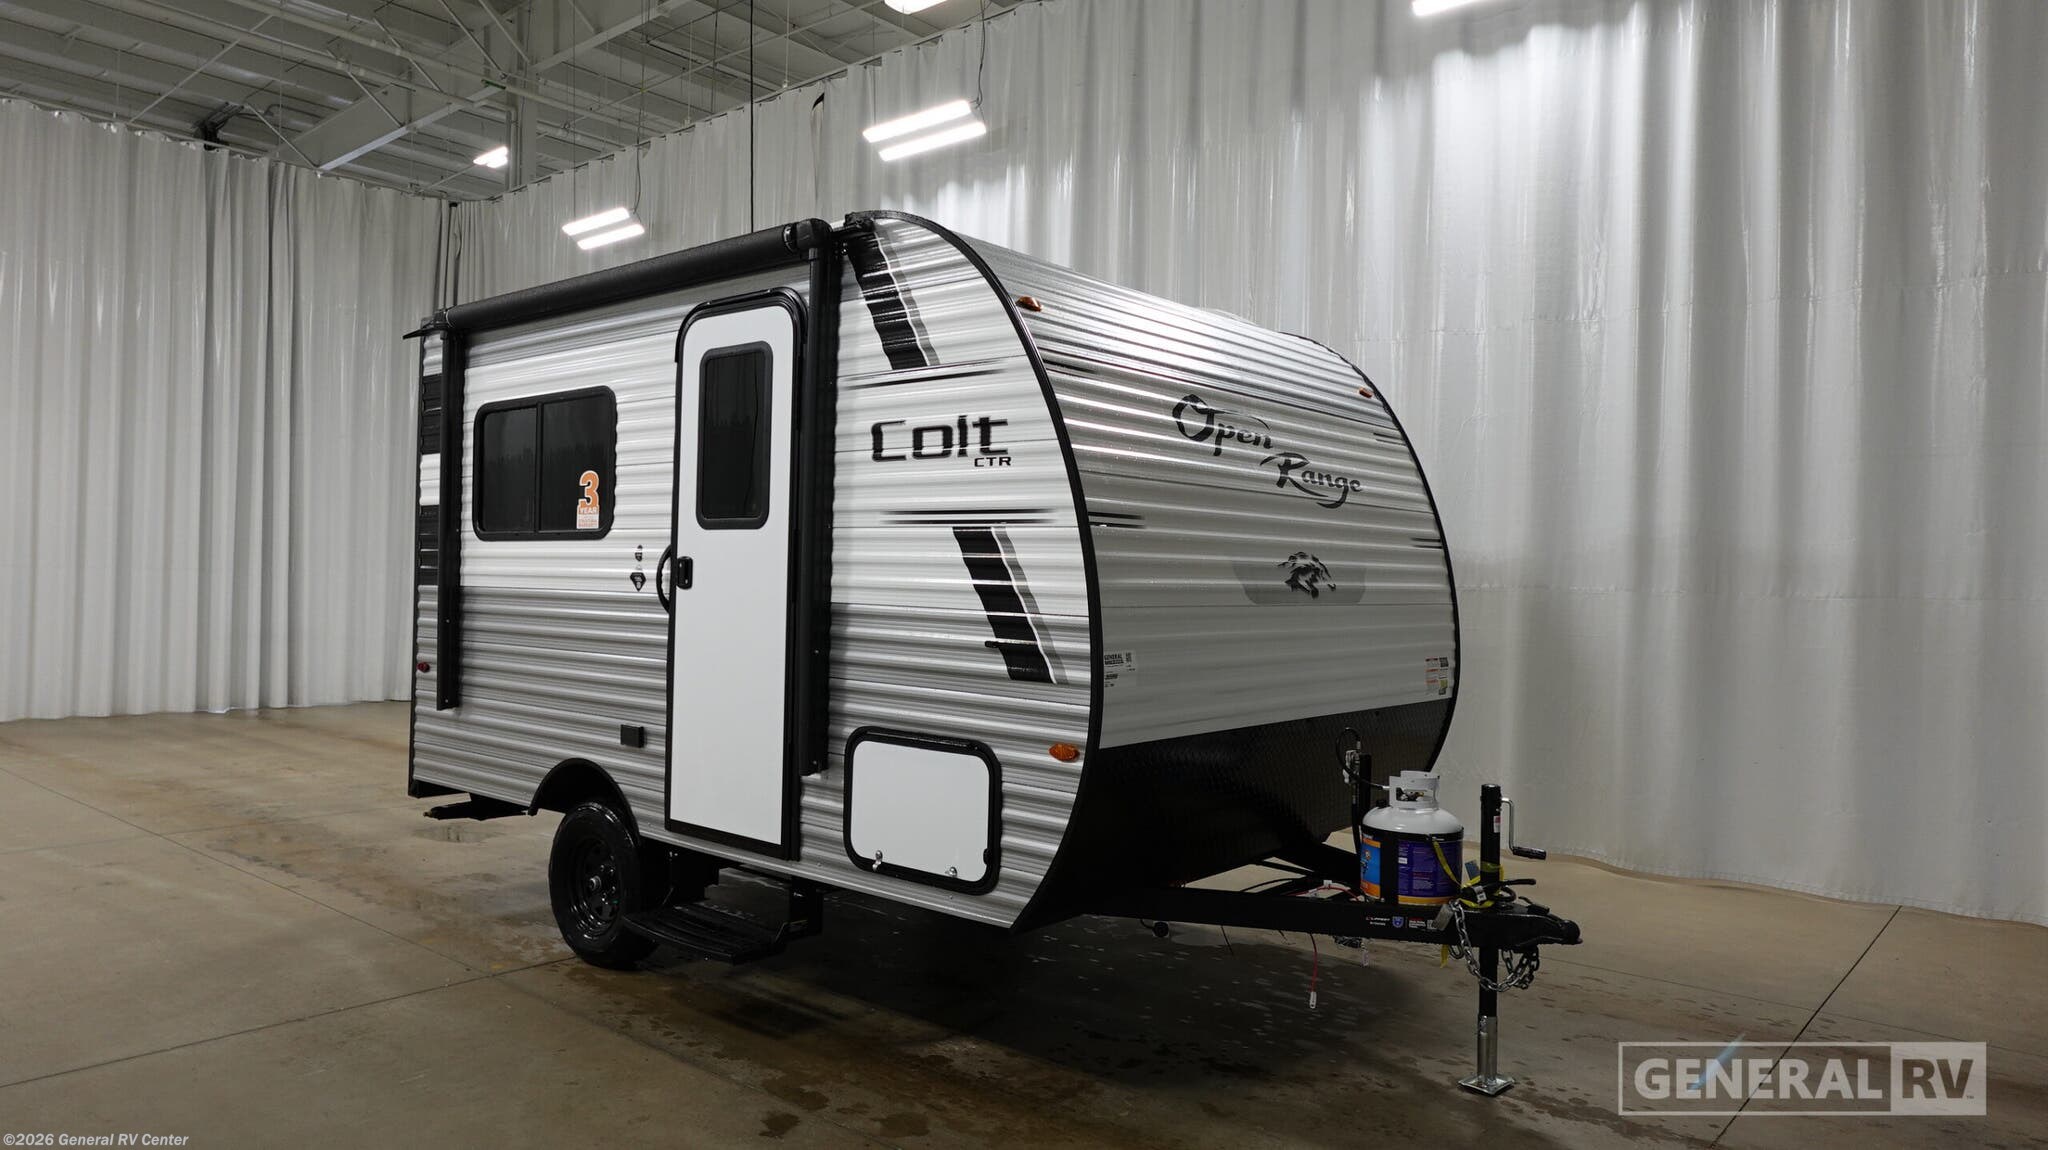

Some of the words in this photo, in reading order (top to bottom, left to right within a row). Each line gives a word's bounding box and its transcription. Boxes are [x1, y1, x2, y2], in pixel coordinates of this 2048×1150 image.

[871, 415, 1009, 462] Colt
[1172, 394, 1273, 456] Open
[974, 456, 1012, 467] CTR
[1260, 452, 1363, 509] Range
[579, 470, 600, 508] 3
